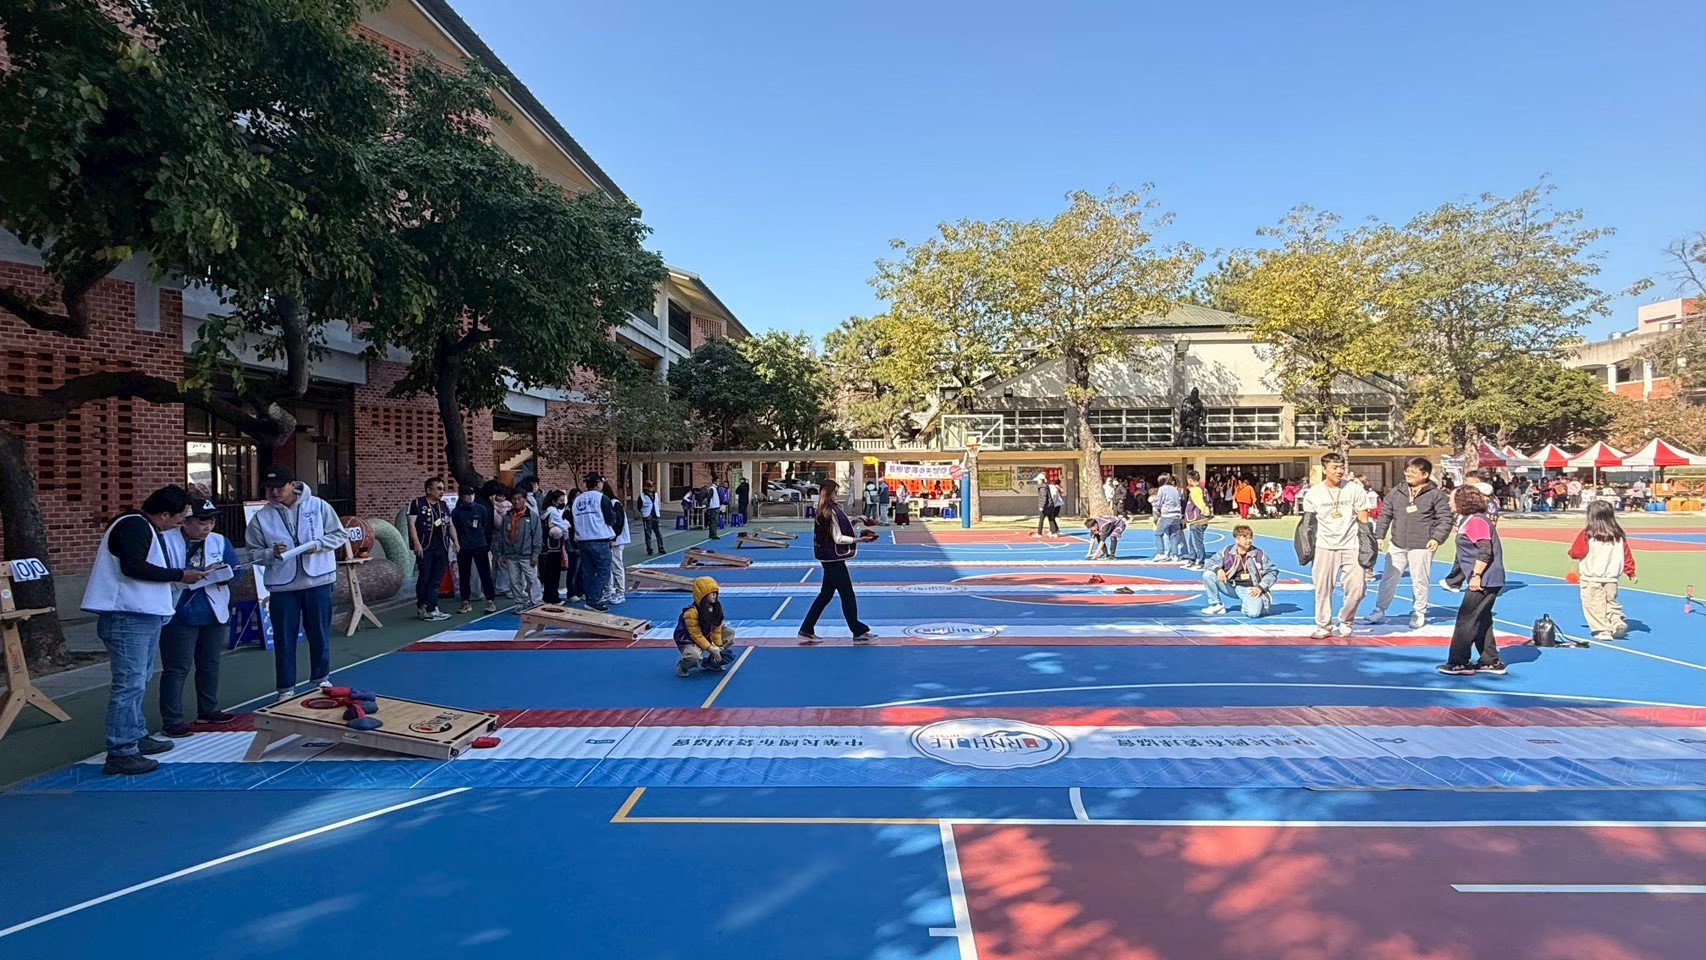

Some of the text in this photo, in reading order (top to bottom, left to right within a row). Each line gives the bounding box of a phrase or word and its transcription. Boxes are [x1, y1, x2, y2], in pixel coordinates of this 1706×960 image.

[350, 528, 361, 540] 08
[16, 560, 46, 577] 00
[671, 738, 864, 747] 中華民國布袋球協會
[1116, 738, 1316, 748] 中華民國布袋球協會
